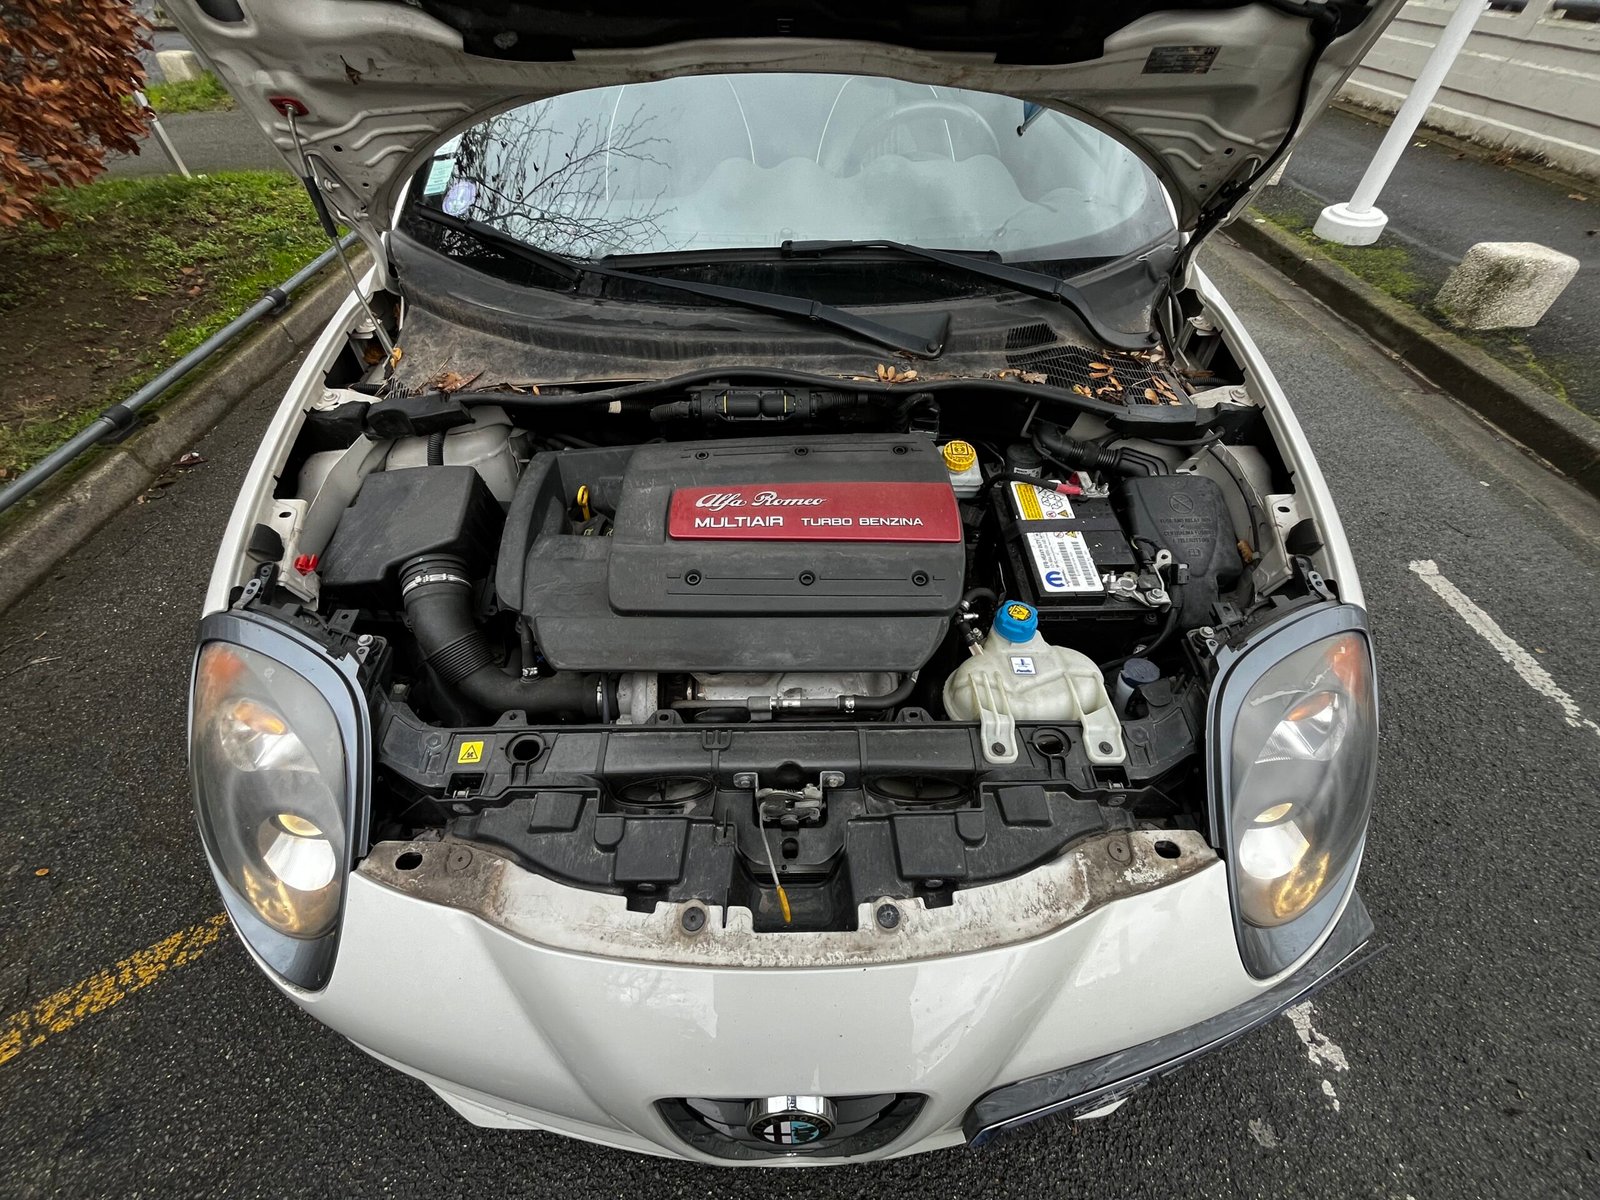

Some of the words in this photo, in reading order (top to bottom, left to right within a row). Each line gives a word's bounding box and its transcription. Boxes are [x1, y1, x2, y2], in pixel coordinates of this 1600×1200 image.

[695, 493, 747, 511] Alfa
[751, 491, 827, 506] Romeo
[694, 516, 784, 528] MULTIAIR
[801, 517, 853, 526] TURBO
[859, 517, 924, 526] BENZINA
